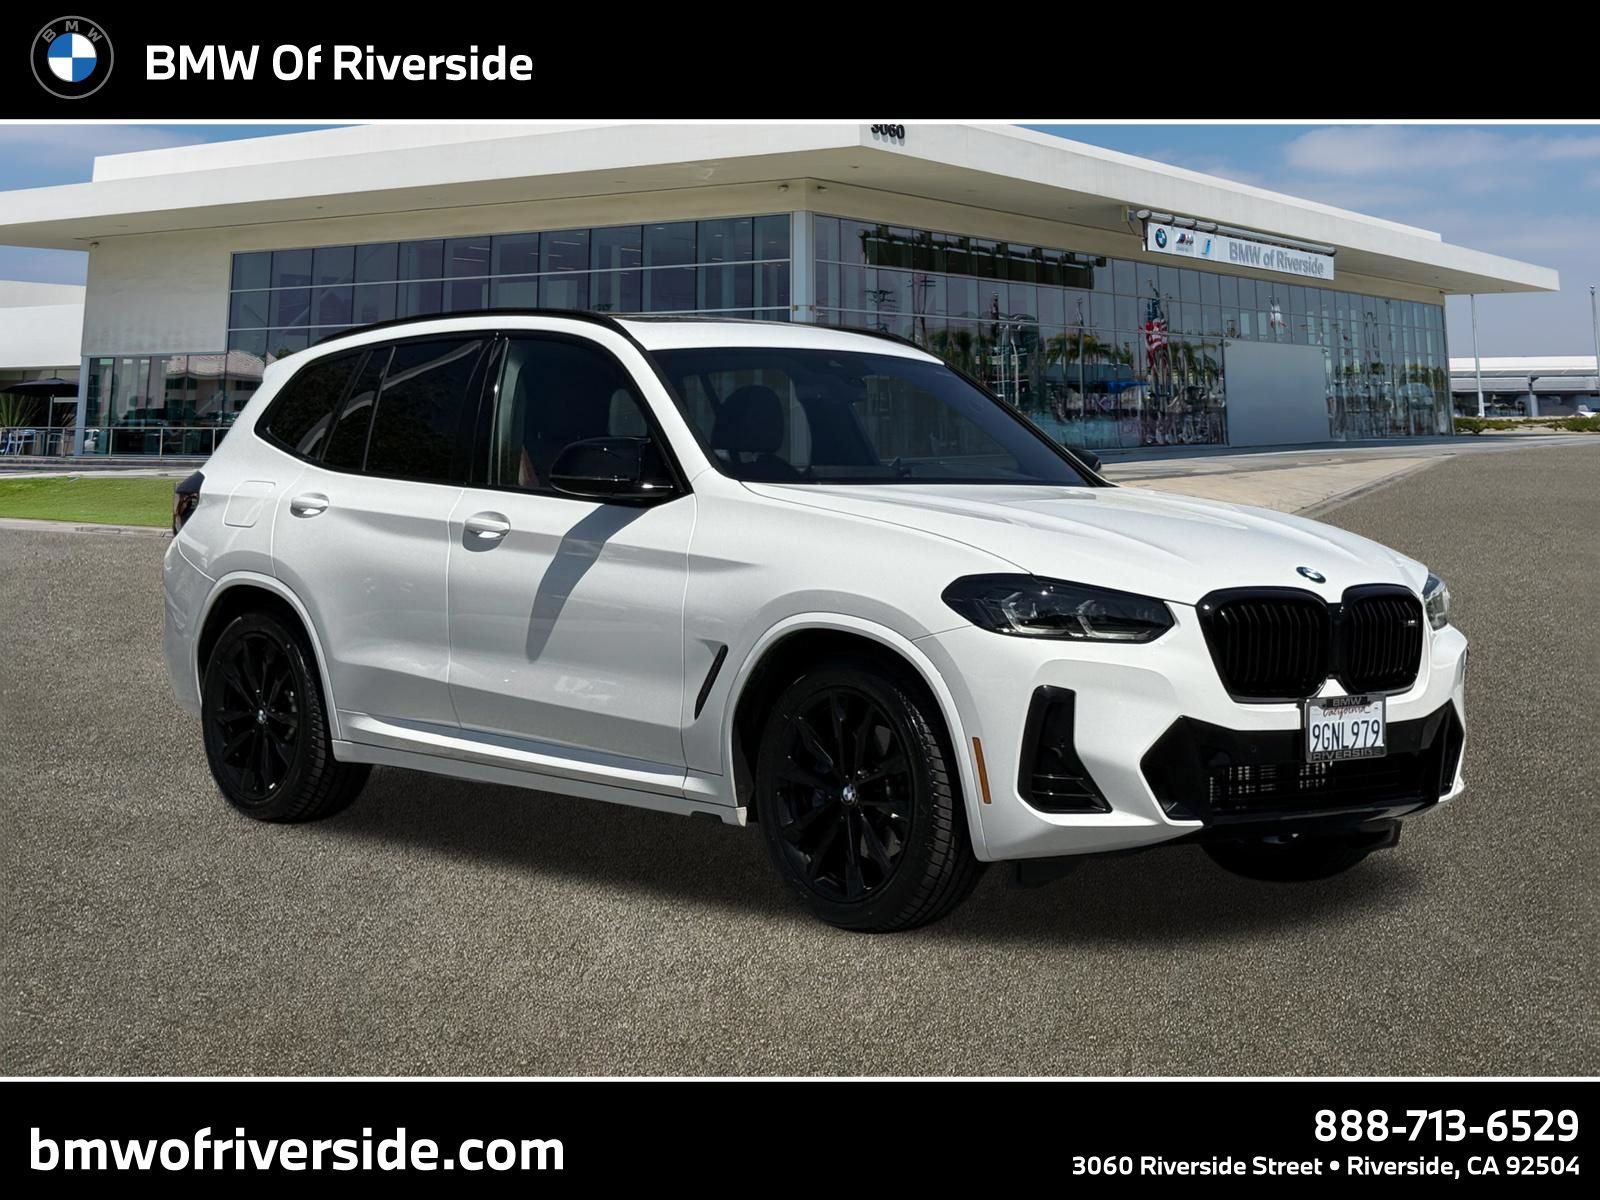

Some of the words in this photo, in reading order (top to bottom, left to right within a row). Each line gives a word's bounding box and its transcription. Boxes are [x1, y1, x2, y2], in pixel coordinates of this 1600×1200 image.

[1229, 241, 1261, 265] BMW
[1263, 249, 1275, 267] of
[1276, 250, 1324, 275] Riverside
[1333, 697, 1362, 708] BMW
